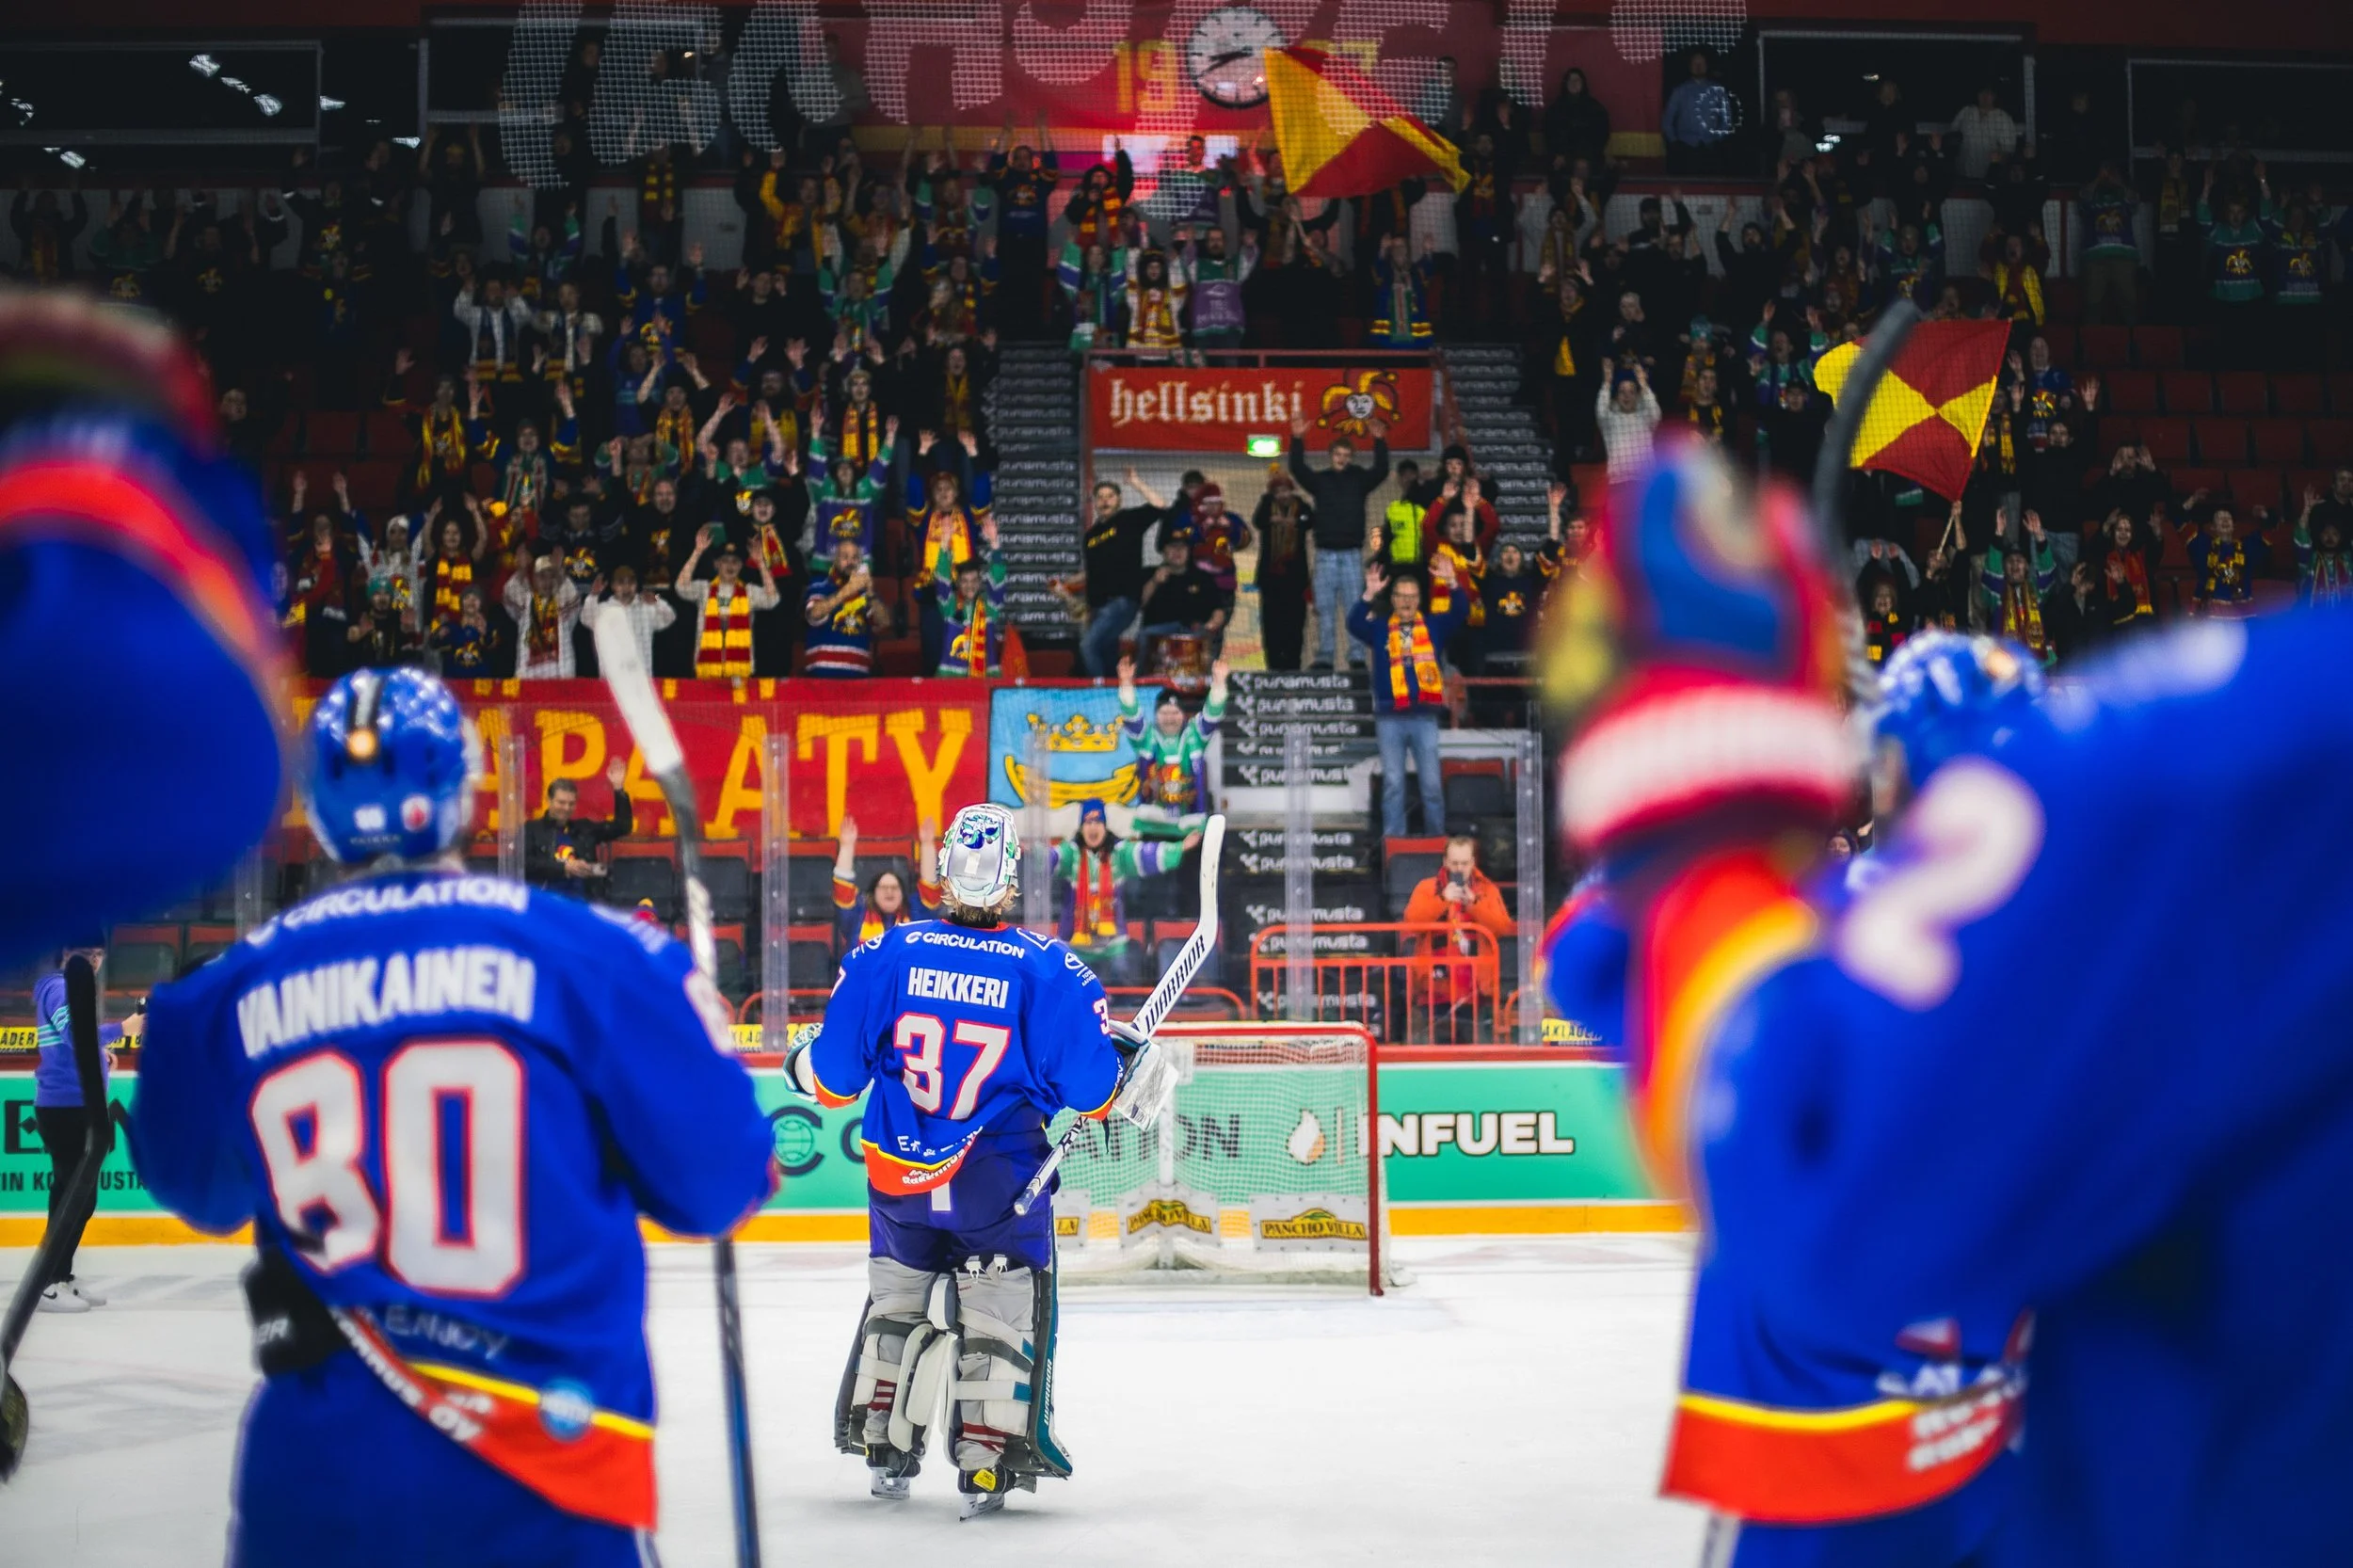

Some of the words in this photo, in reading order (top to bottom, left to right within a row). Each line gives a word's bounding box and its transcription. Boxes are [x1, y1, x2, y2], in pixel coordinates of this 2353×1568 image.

[1254, 675, 1352, 689] punamusta
[1257, 695, 1354, 712] punamusta
[285, 876, 529, 926] CIRCULATION
[922, 931, 1025, 959] CIRCULATION
[907, 967, 1010, 1009] HEIKKERI
[1145, 934, 1206, 1033] WARRIOR
[894, 1011, 1011, 1121] 37
[251, 1040, 527, 1299] 80
[1264, 1223, 1324, 1236] PANCHO
[1325, 1223, 1364, 1237] VILLA
